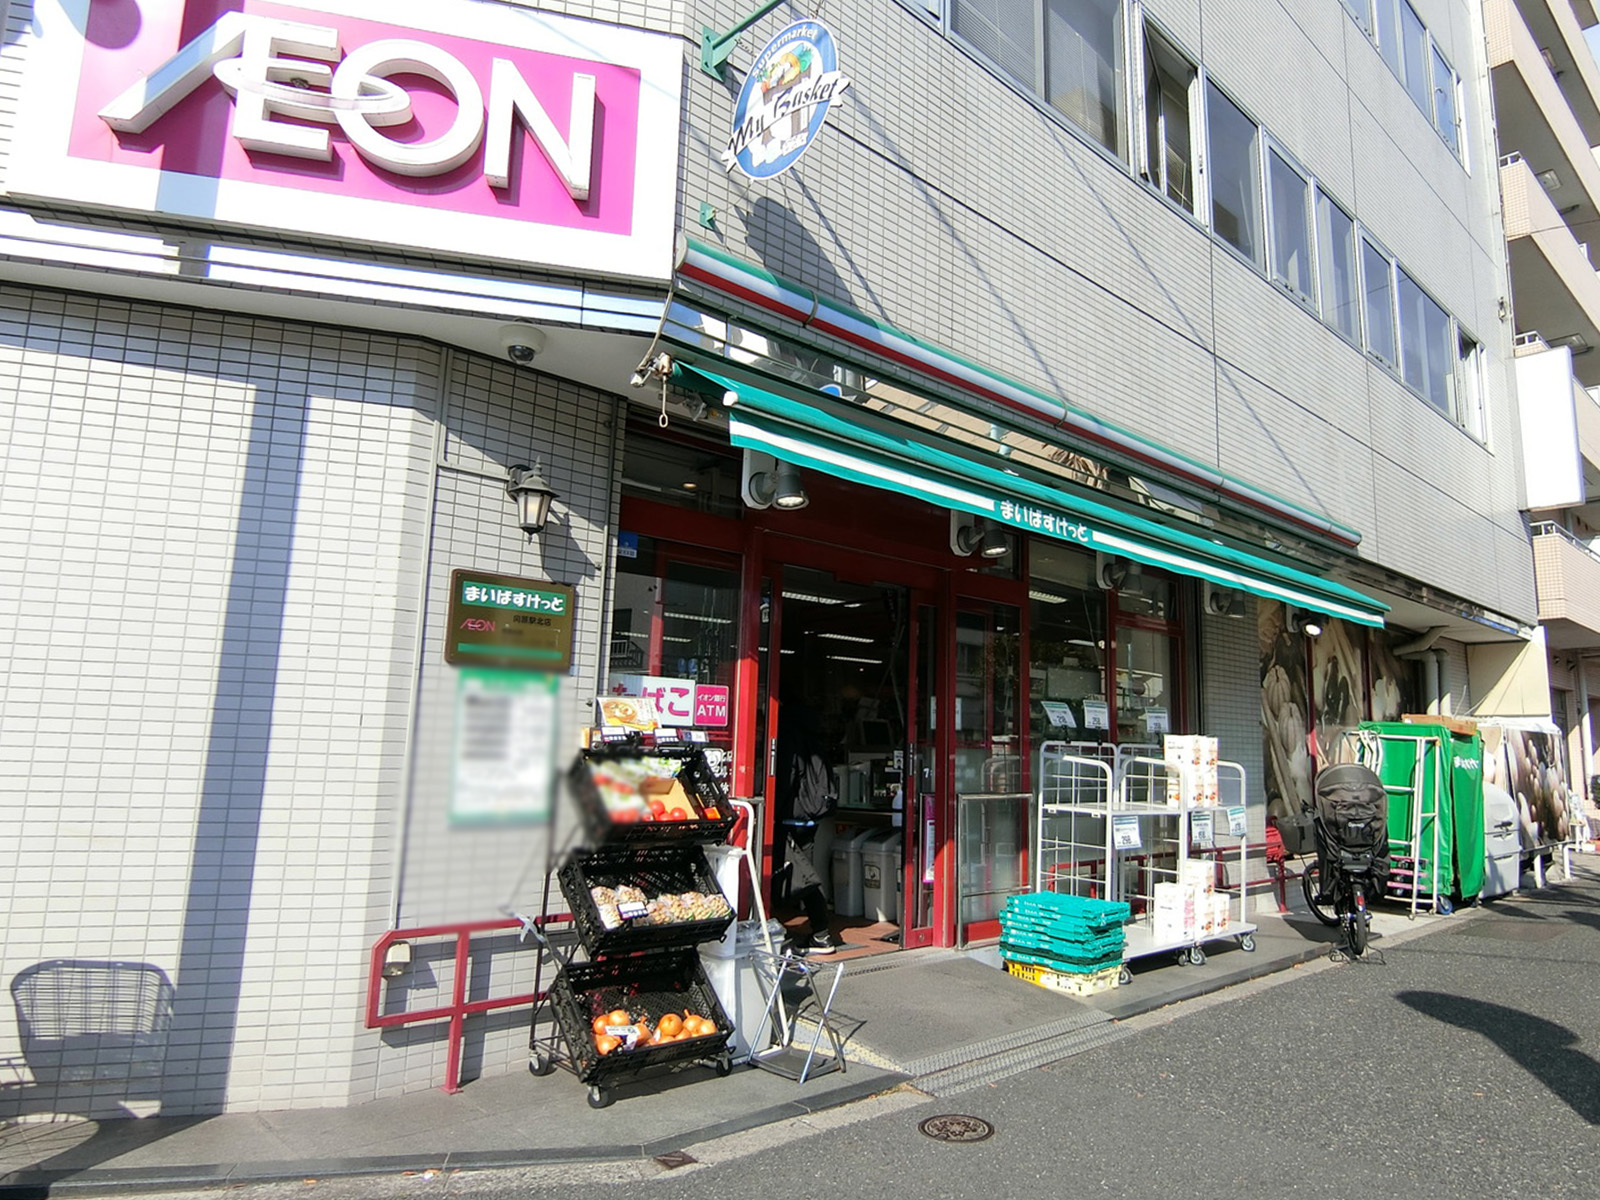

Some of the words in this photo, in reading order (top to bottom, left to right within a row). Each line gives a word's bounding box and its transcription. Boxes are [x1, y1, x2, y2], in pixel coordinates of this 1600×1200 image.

[752, 25, 818, 79] supermarket
[98, 11, 596, 200] AEON
[728, 115, 764, 155] My
[774, 75, 838, 117] Basket
[1000, 500, 1088, 542] まいばすけっと
[464, 586, 564, 612] まいばすけっと
[460, 618, 496, 632] AEON
[697, 705, 726, 717] ATM
